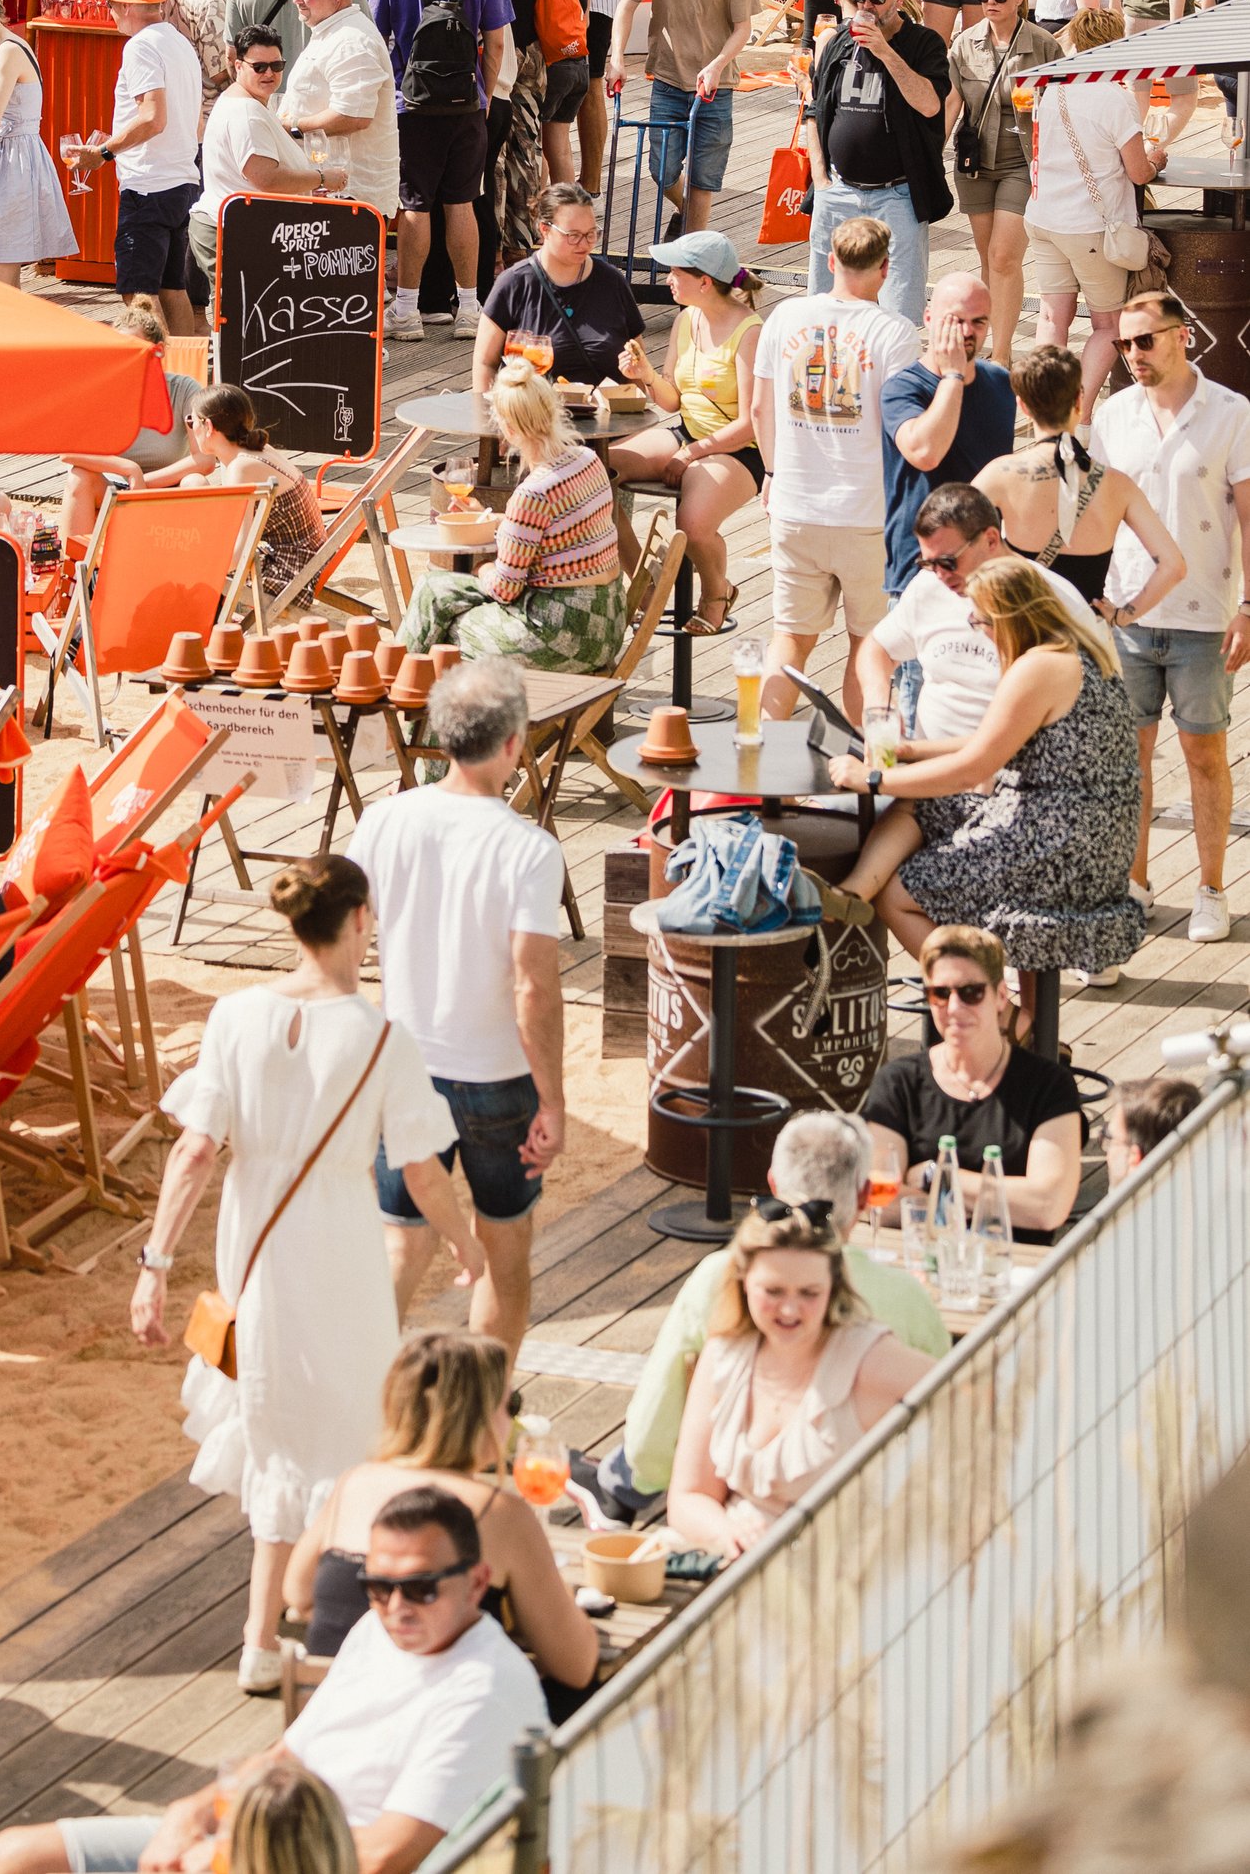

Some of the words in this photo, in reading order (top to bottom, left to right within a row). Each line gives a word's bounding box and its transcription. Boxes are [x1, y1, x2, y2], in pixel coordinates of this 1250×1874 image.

[271, 221, 331, 244] APEROL
[303, 244, 377, 280] POMMES
[240, 270, 373, 343] Kasse
[259, 707, 275, 718] für
[279, 709, 299, 720] den
[792, 987, 887, 1039] SLITOS
